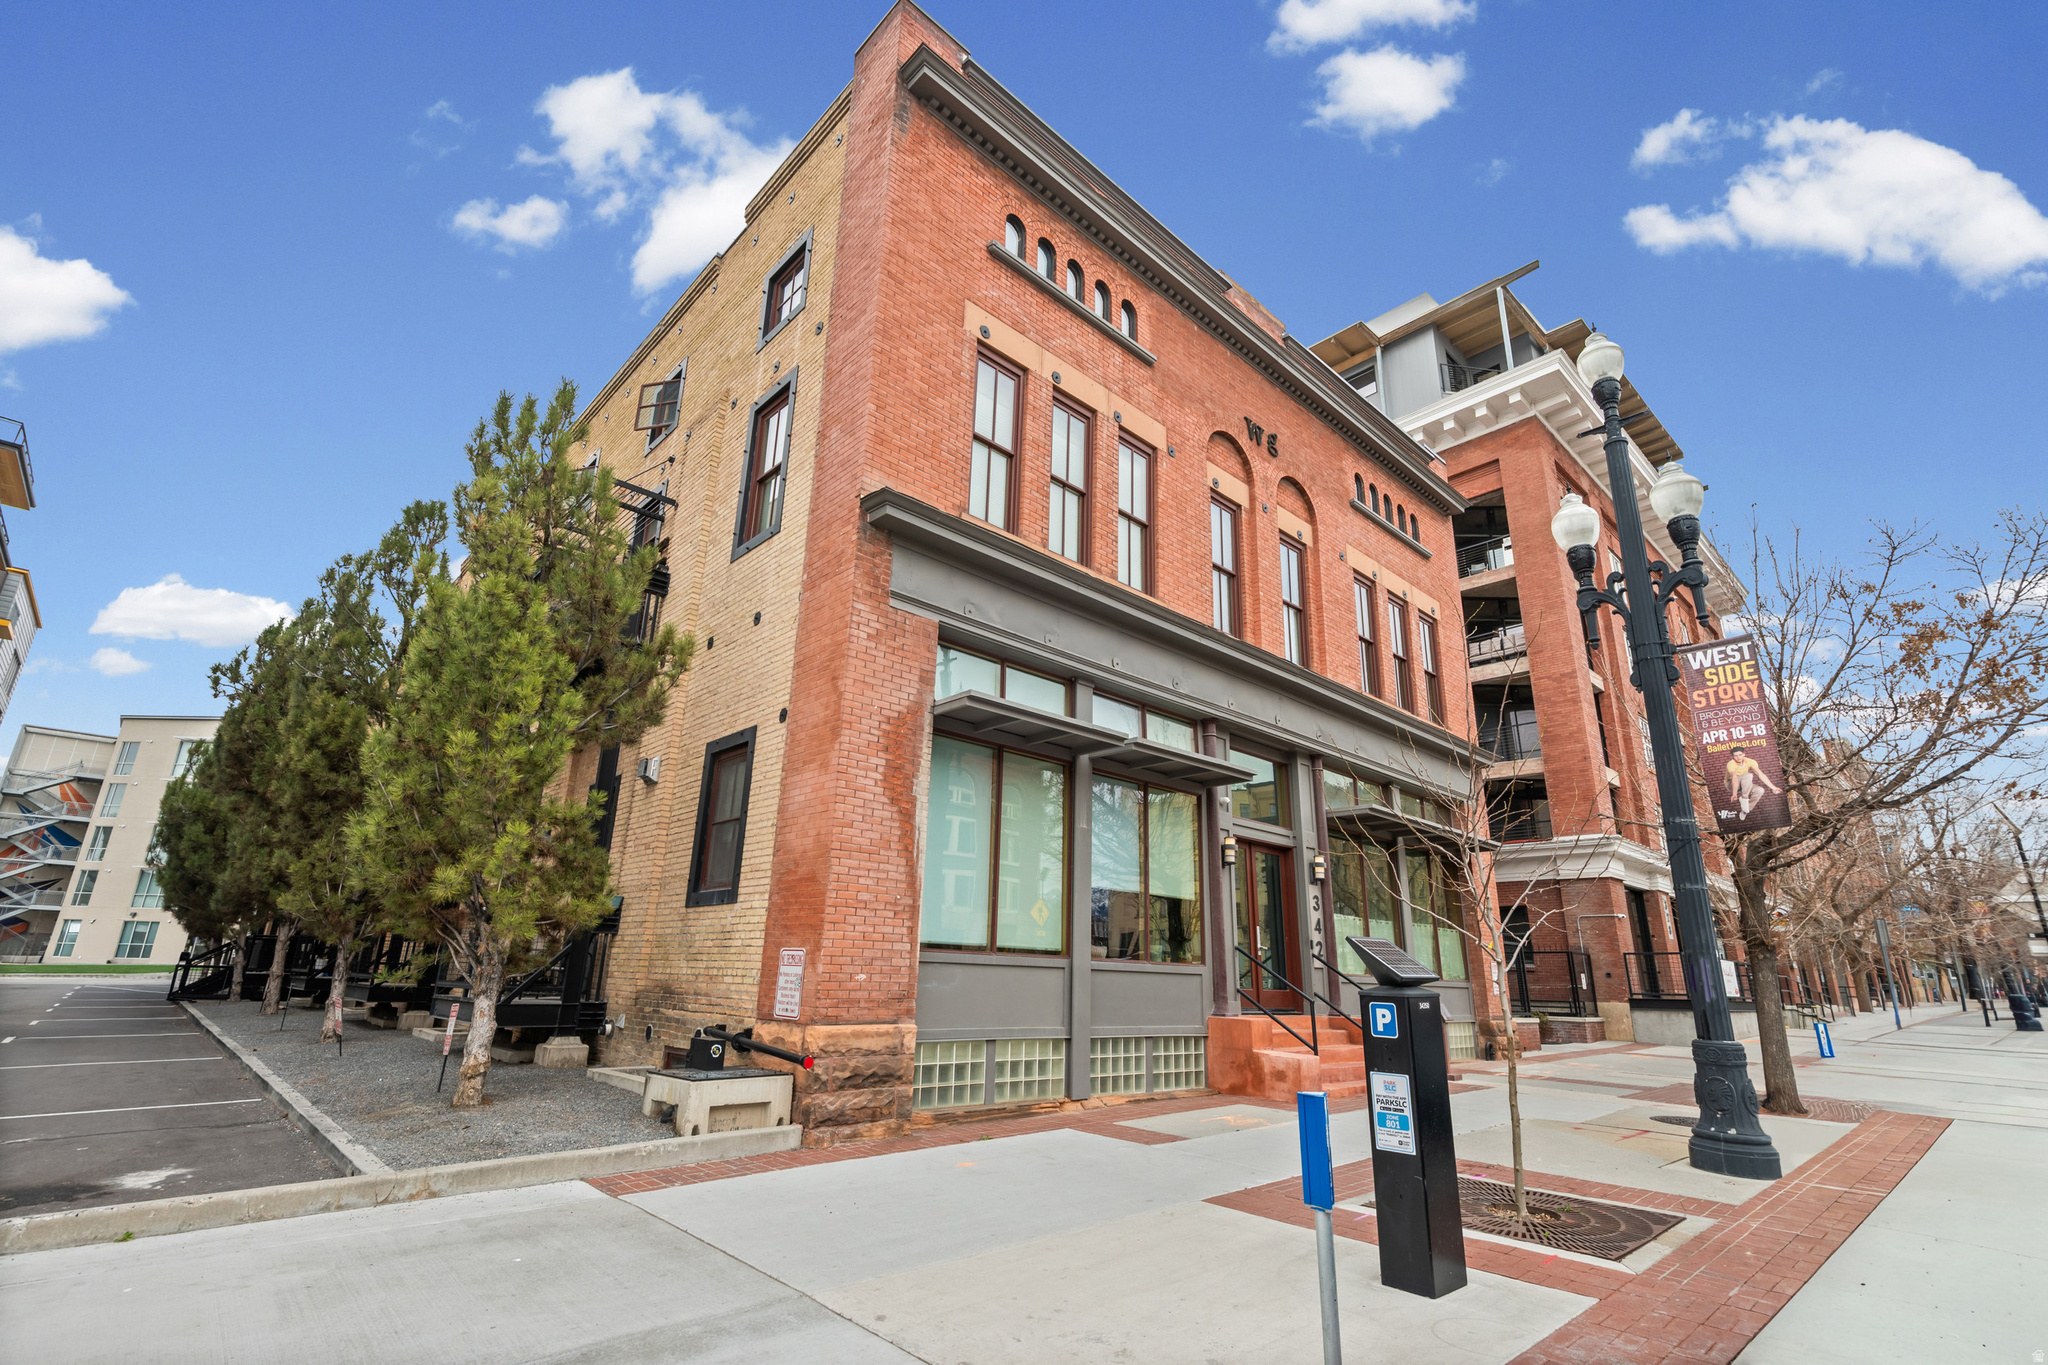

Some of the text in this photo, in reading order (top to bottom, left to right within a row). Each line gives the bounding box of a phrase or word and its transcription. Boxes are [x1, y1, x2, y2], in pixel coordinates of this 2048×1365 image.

[1687, 641, 1752, 670] WEST
[1704, 661, 1758, 686] SIDE
[1692, 679, 1760, 708] STORY
[1699, 704, 1760, 721] BROADWAY
[1702, 712, 1761, 729] & BEYOND
[1702, 728, 1728, 745] APR
[1706, 736, 1767, 753] BalletWest.org
[1376, 1008, 1391, 1031] P
[1376, 1098, 1407, 1108] PARKSLC
[1386, 1119, 1400, 1129] 801
